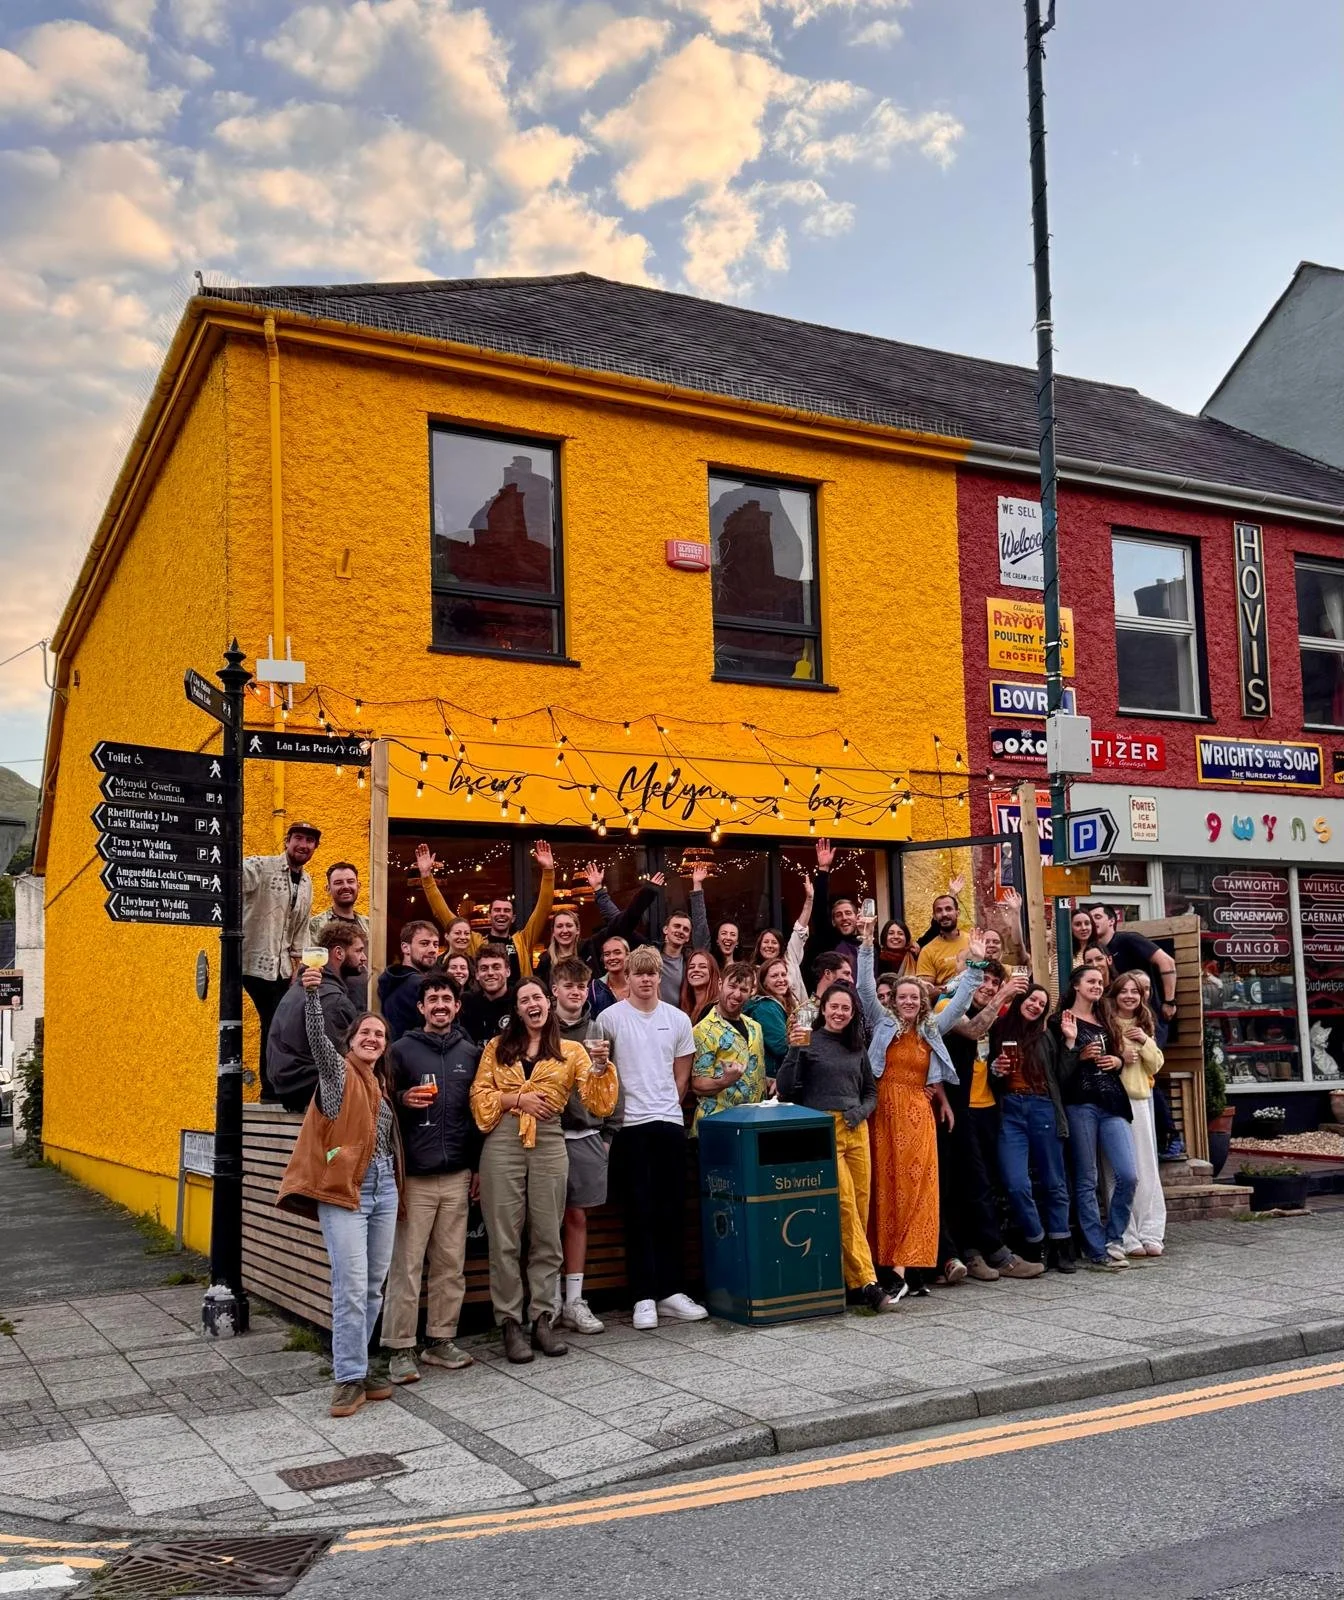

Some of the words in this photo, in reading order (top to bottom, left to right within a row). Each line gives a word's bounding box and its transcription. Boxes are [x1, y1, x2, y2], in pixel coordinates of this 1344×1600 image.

[1002, 503, 1014, 514] WE
[1018, 506, 1037, 518] SELL
[1239, 527, 1266, 712] HOVIS
[995, 630, 1034, 645] POULTRY
[1000, 688, 1049, 712] BOVR
[295, 742, 310, 752] Las
[1004, 737, 1048, 755] OXO
[1091, 739, 1159, 762] TIZER
[106, 751, 131, 763] Toilet
[1200, 743, 1264, 768] WRIGHT'S
[1264, 750, 1283, 759] COAL
[1283, 748, 1319, 771] SOAP
[1267, 760, 1281, 768] TAR
[1231, 770, 1244, 778] THE
[1246, 771, 1276, 779] NURSERY
[115, 777, 148, 790] Mynydd
[151, 782, 180, 792] Gwefru
[617, 761, 723, 821] Melyn
[808, 784, 856, 811] bar
[115, 788, 146, 799] Electric
[148, 791, 185, 803] Mountain
[107, 807, 153, 820] Rheilffordd
[154, 814, 160, 822] y
[161, 812, 179, 823] Llyn
[107, 818, 127, 828] Lake
[129, 820, 160, 832] Railway
[111, 836, 130, 846] Tren
[132, 840, 141, 848] yr
[142, 839, 171, 850] Wyddfa
[1079, 824, 1093, 849] P
[111, 847, 146, 858] Snowdon
[148, 850, 178, 862] Railway
[116, 866, 157, 878] Amgueddfa
[157, 869, 177, 879] Lechi
[177, 871, 201, 882] Cymru
[1099, 865, 1121, 882] 41A
[116, 877, 139, 887] Welsh
[140, 879, 159, 889] Slate
[160, 880, 190, 891] Museum
[1221, 879, 1280, 891] TAMWORTH
[161, 899, 189, 910] Wyddfa
[120, 906, 153, 917] Snowdon
[155, 909, 191, 920] Footpaths
[1220, 911, 1284, 922] PENMAENMAWR
[1301, 912, 1344, 922] CAERNAR
[1226, 943, 1280, 953] BANGOR
[1303, 943, 1332, 951] HOLYWELL
[775, 1174, 821, 1190] Sbwriel
